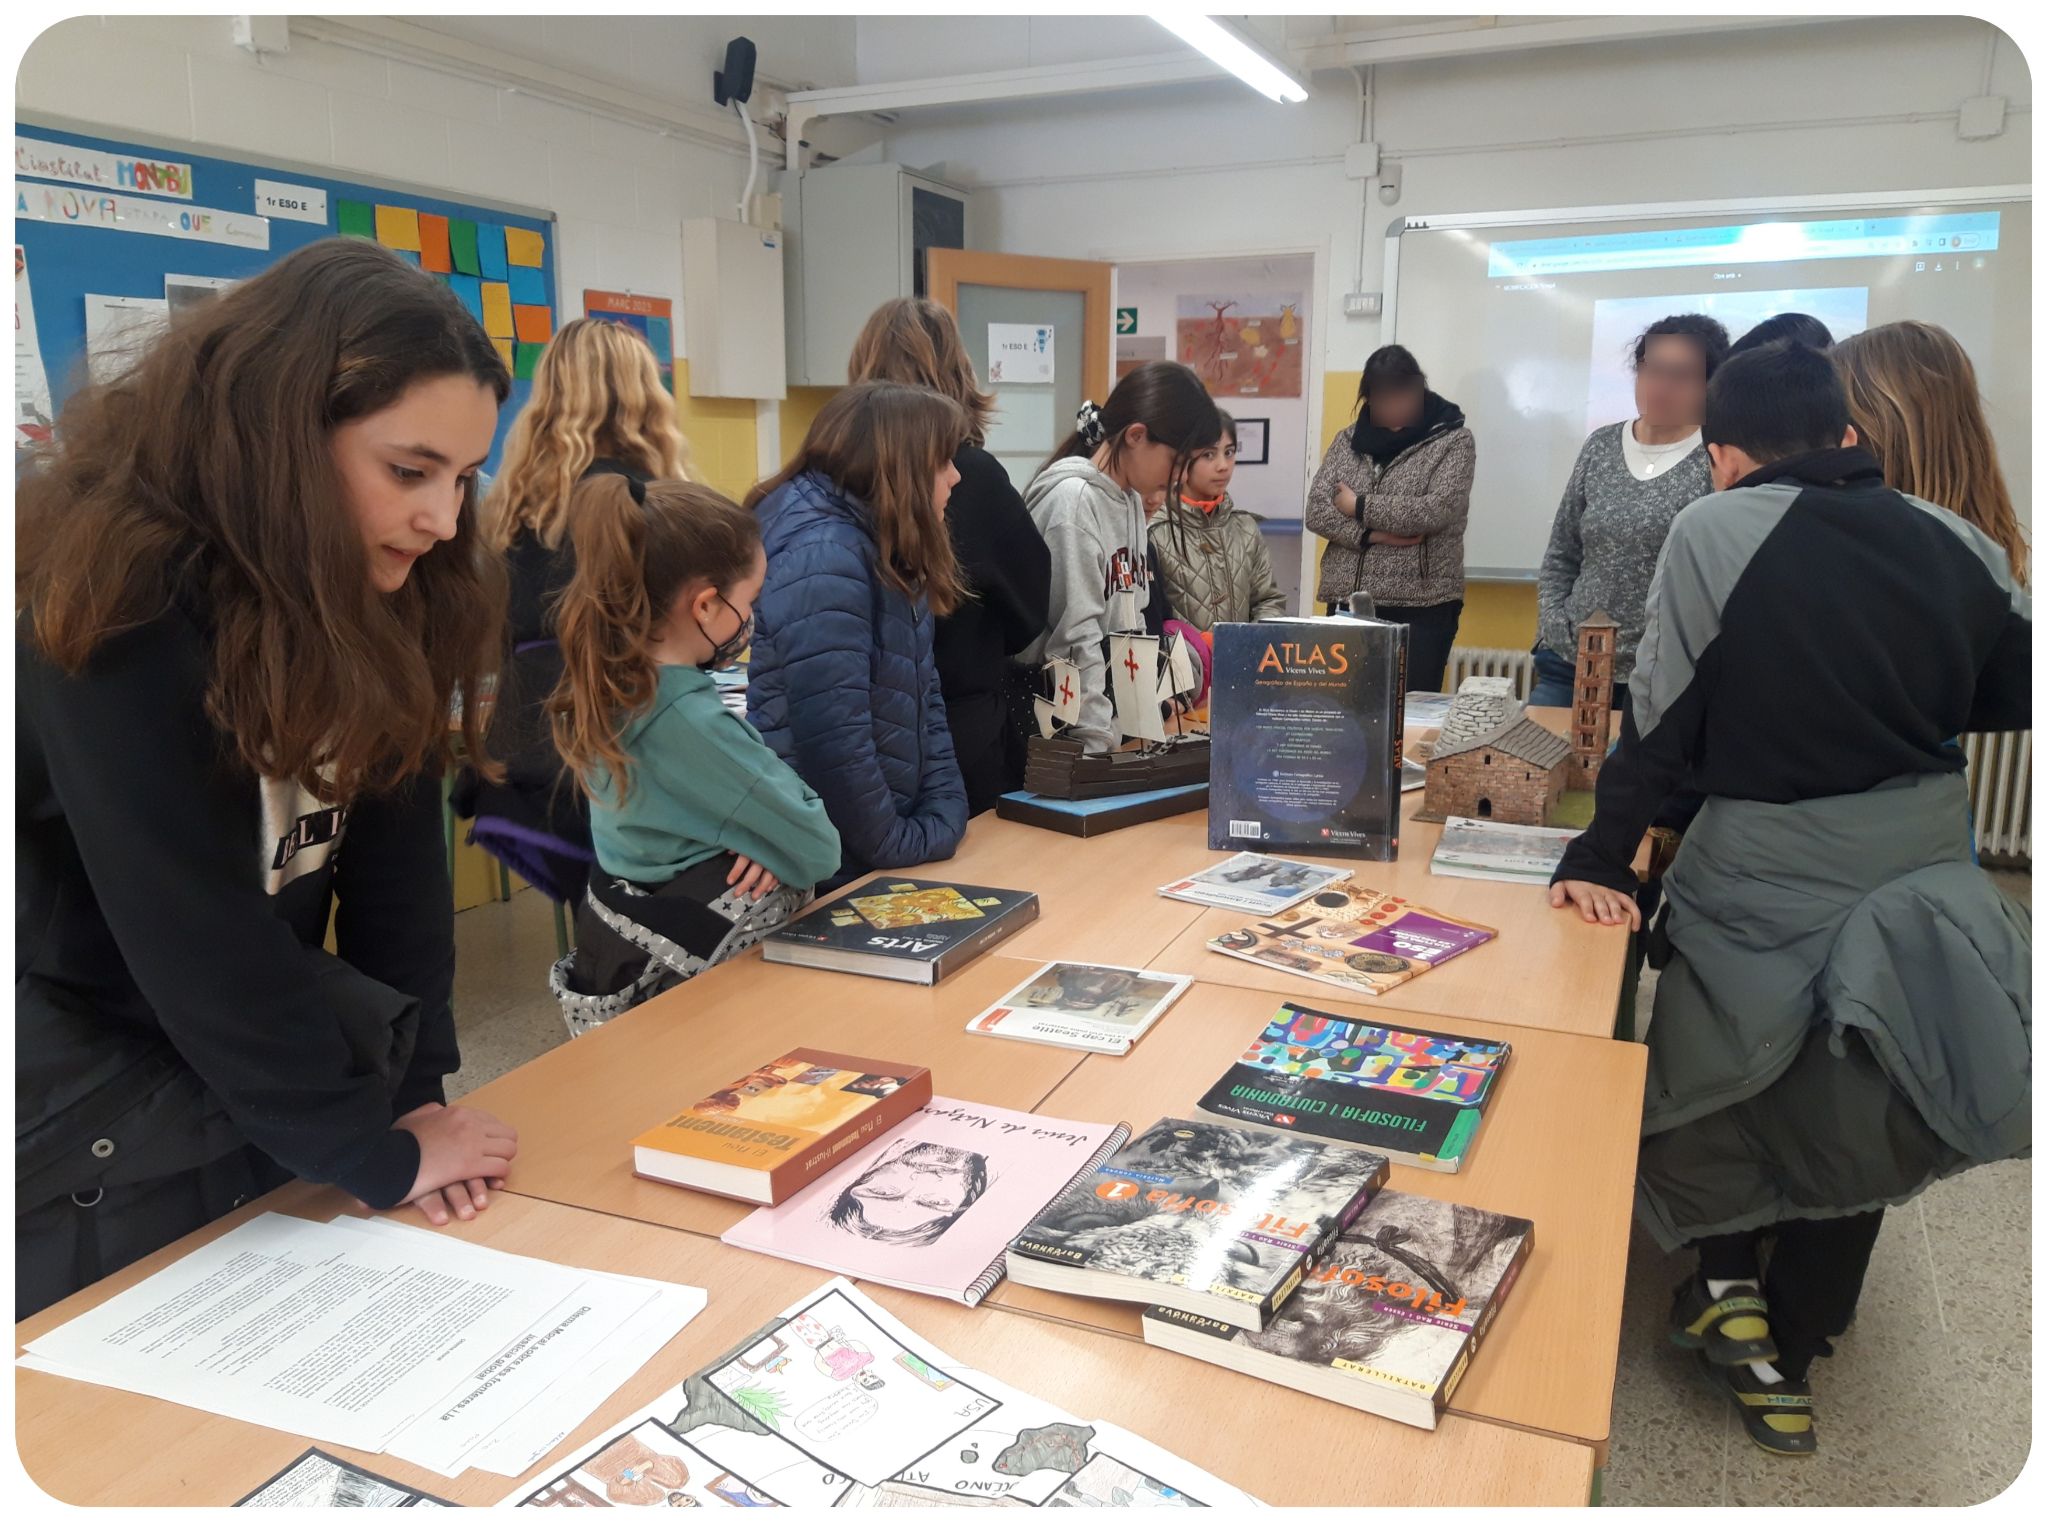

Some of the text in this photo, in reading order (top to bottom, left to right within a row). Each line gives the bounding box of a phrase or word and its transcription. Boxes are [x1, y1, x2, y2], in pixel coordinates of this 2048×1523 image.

[279, 198, 298, 210] ESO
[301, 201, 307, 210] E
[1256, 642, 1348, 675] ATLAS
[1285, 666, 1326, 675] Vicens Vives
[1394, 739, 1403, 769] ATLAS
[867, 935, 939, 954] Arts
[1393, 941, 1443, 955] ESO
[1032, 1025, 1079, 1038] Seattle
[1082, 1033, 1105, 1042] cap
[1217, 1103, 1241, 1115] Vives
[1229, 1084, 1428, 1133] FILOSOFIA I CIUTADANIA
[1242, 1109, 1271, 1121] Vicens
[666, 1114, 801, 1153] Testament
[1000, 1122, 1026, 1136] de
[1032, 1128, 1087, 1147] Jesús
[832, 1129, 860, 1155] Testament
[755, 1148, 769, 1158] El
[1018, 1238, 1084, 1261] Barcanova
[561, 1306, 591, 1328] Dilema
[538, 1328, 564, 1346] Moral
[513, 1346, 539, 1367] sobre
[474, 1358, 505, 1381] global
[499, 1364, 516, 1377] les
[1341, 1361, 1427, 1391] BATXILLERAT
[456, 1375, 501, 1409] fronteres
[440, 1410, 455, 1421] la
[953, 1396, 989, 1419] USA
